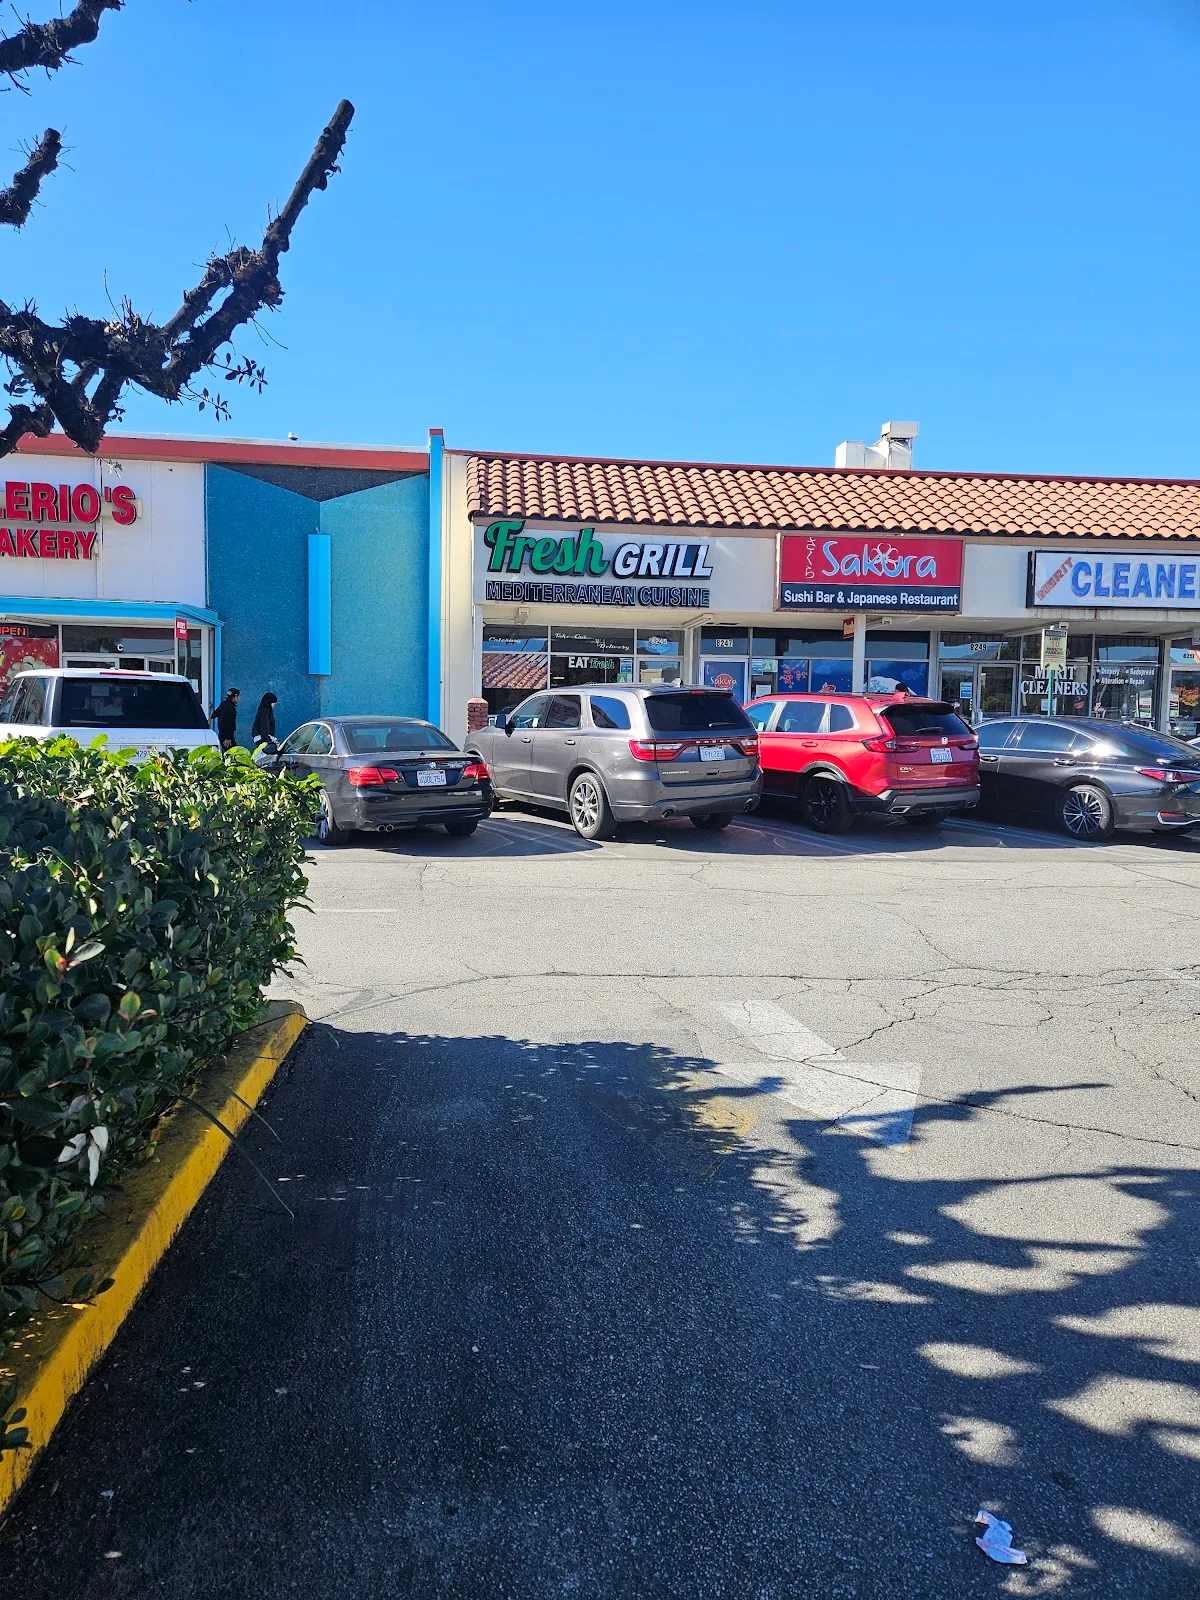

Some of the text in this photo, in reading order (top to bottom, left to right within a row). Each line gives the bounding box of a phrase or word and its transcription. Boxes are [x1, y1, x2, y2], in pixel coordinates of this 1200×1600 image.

[0, 481, 137, 525] ERIO'S
[484, 520, 713, 580] Fresh GRILL
[805, 537, 816, 579] さくら
[822, 540, 937, 579] Sakura
[486, 580, 710, 607] MEDITERRANEAN CUISINE
[1036, 556, 1074, 600] MERIT
[784, 590, 958, 606] Sushi Bar & Japanese Restaurant
[0, 627, 26, 636] PEN
[568, 656, 589, 668] EAT
